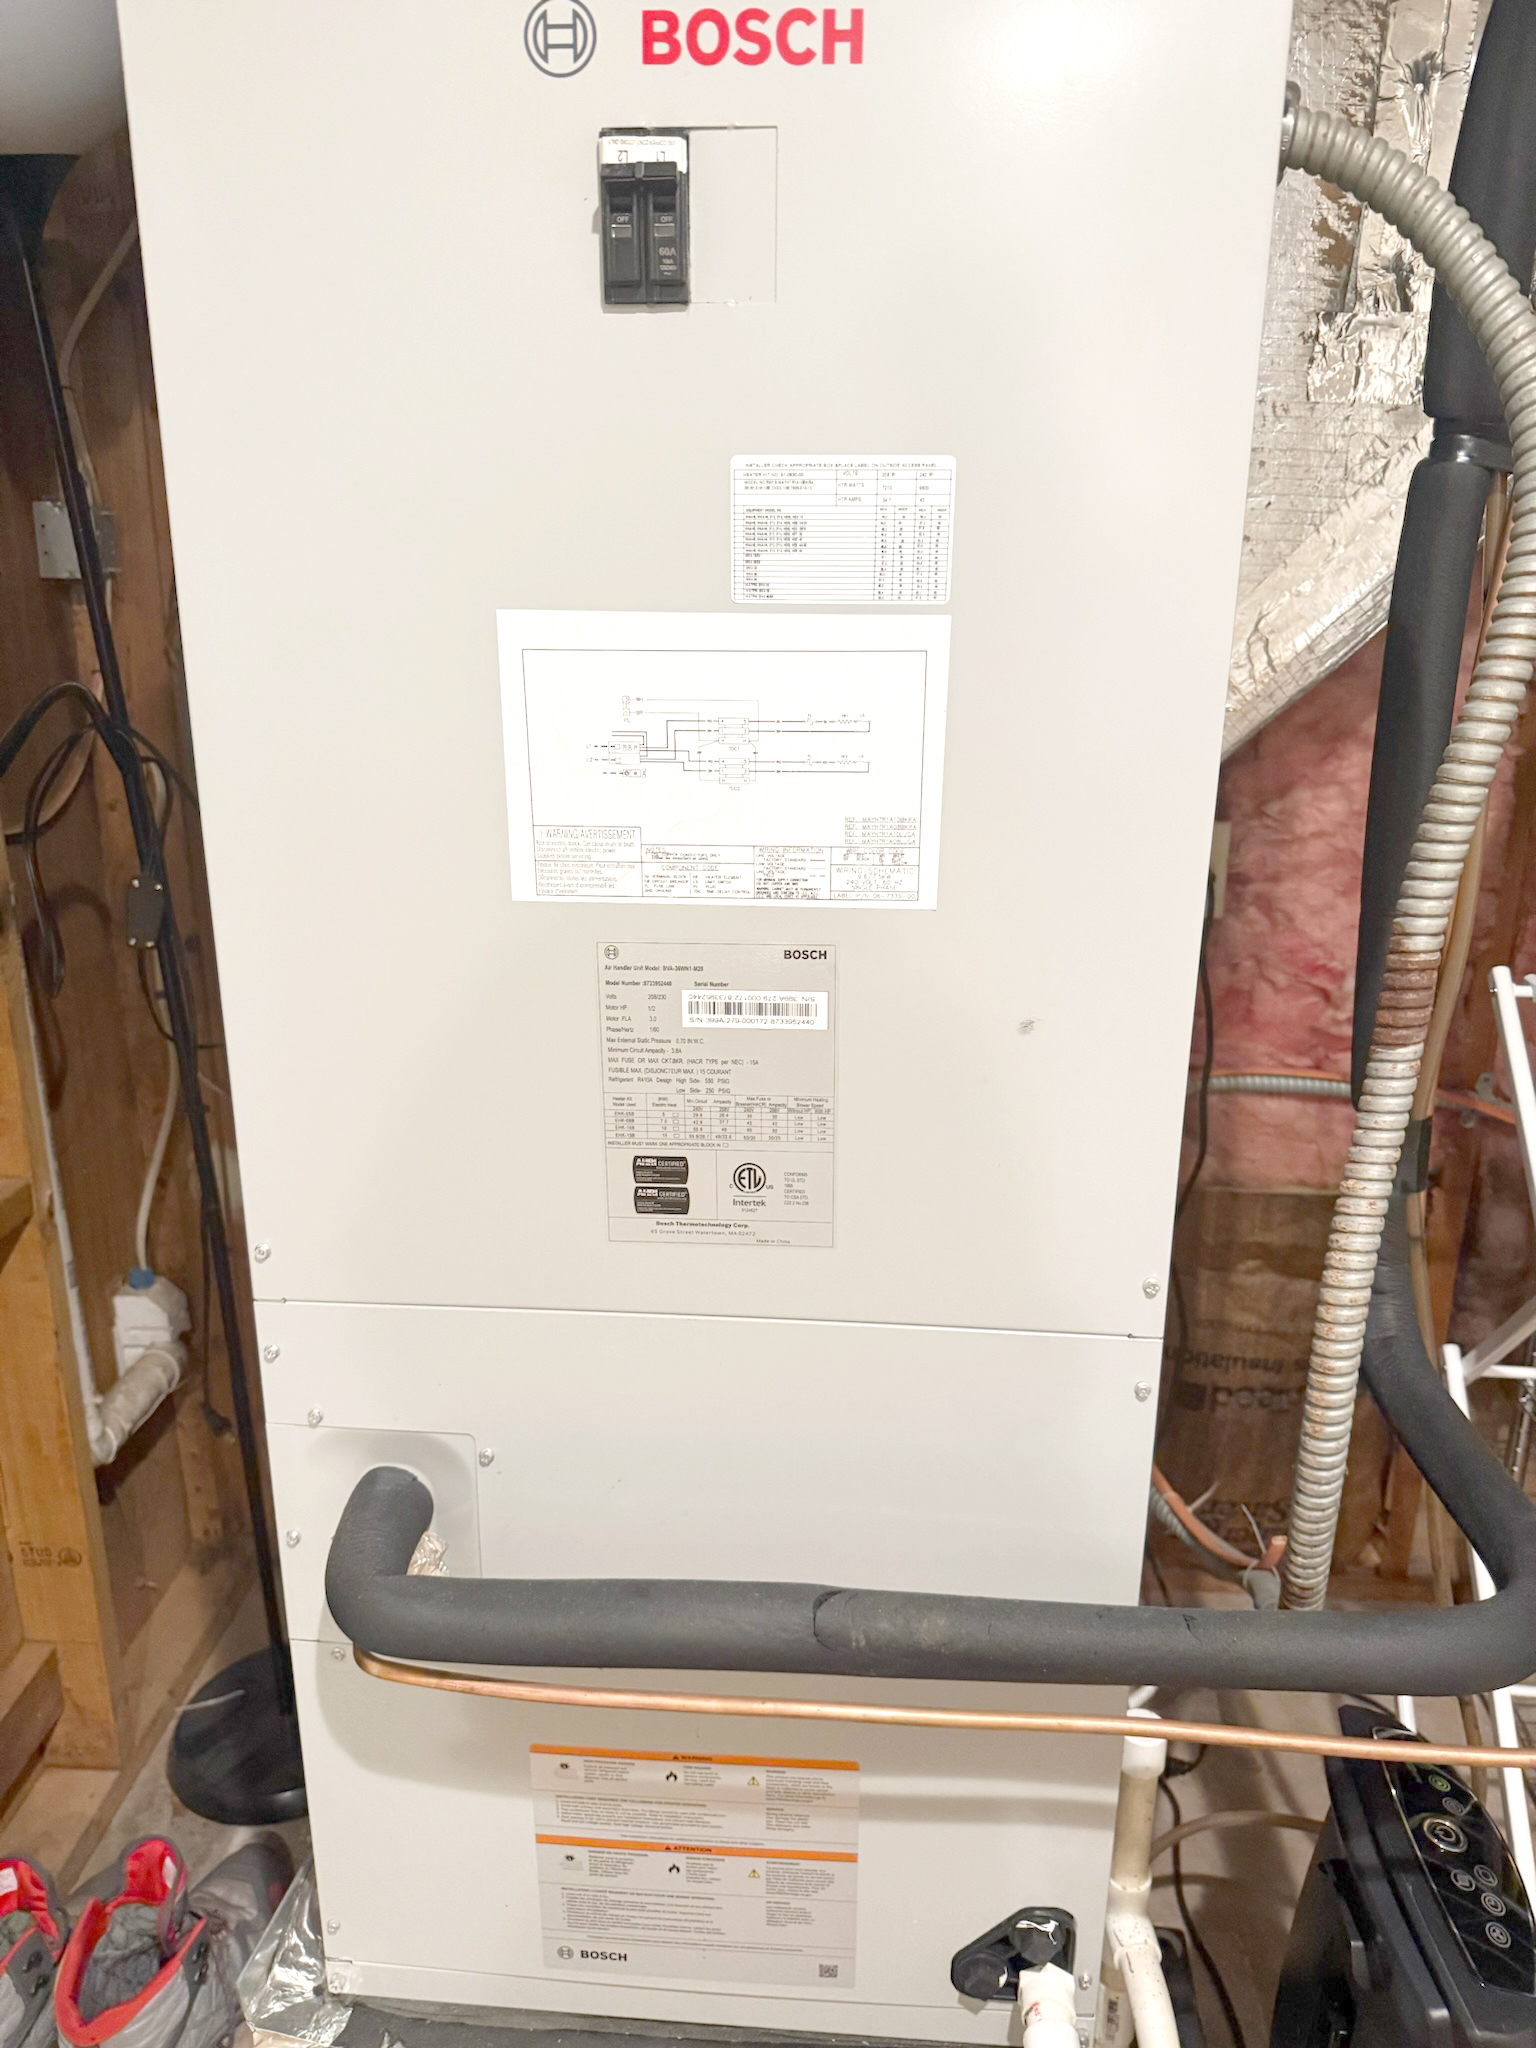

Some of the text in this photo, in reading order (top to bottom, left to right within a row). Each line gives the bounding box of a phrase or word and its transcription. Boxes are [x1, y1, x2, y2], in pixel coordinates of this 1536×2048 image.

[642, 8, 864, 65] BOSCH
[618, 150, 628, 163] L2
[657, 151, 665, 162] L1
[659, 247, 676, 255] 60A
[784, 950, 827, 960] BOSCH
[733, 1198, 766, 1207] Intertek
[676, 1221, 732, 1229] Thermotechnology
[580, 1950, 627, 1962] BOSCH
